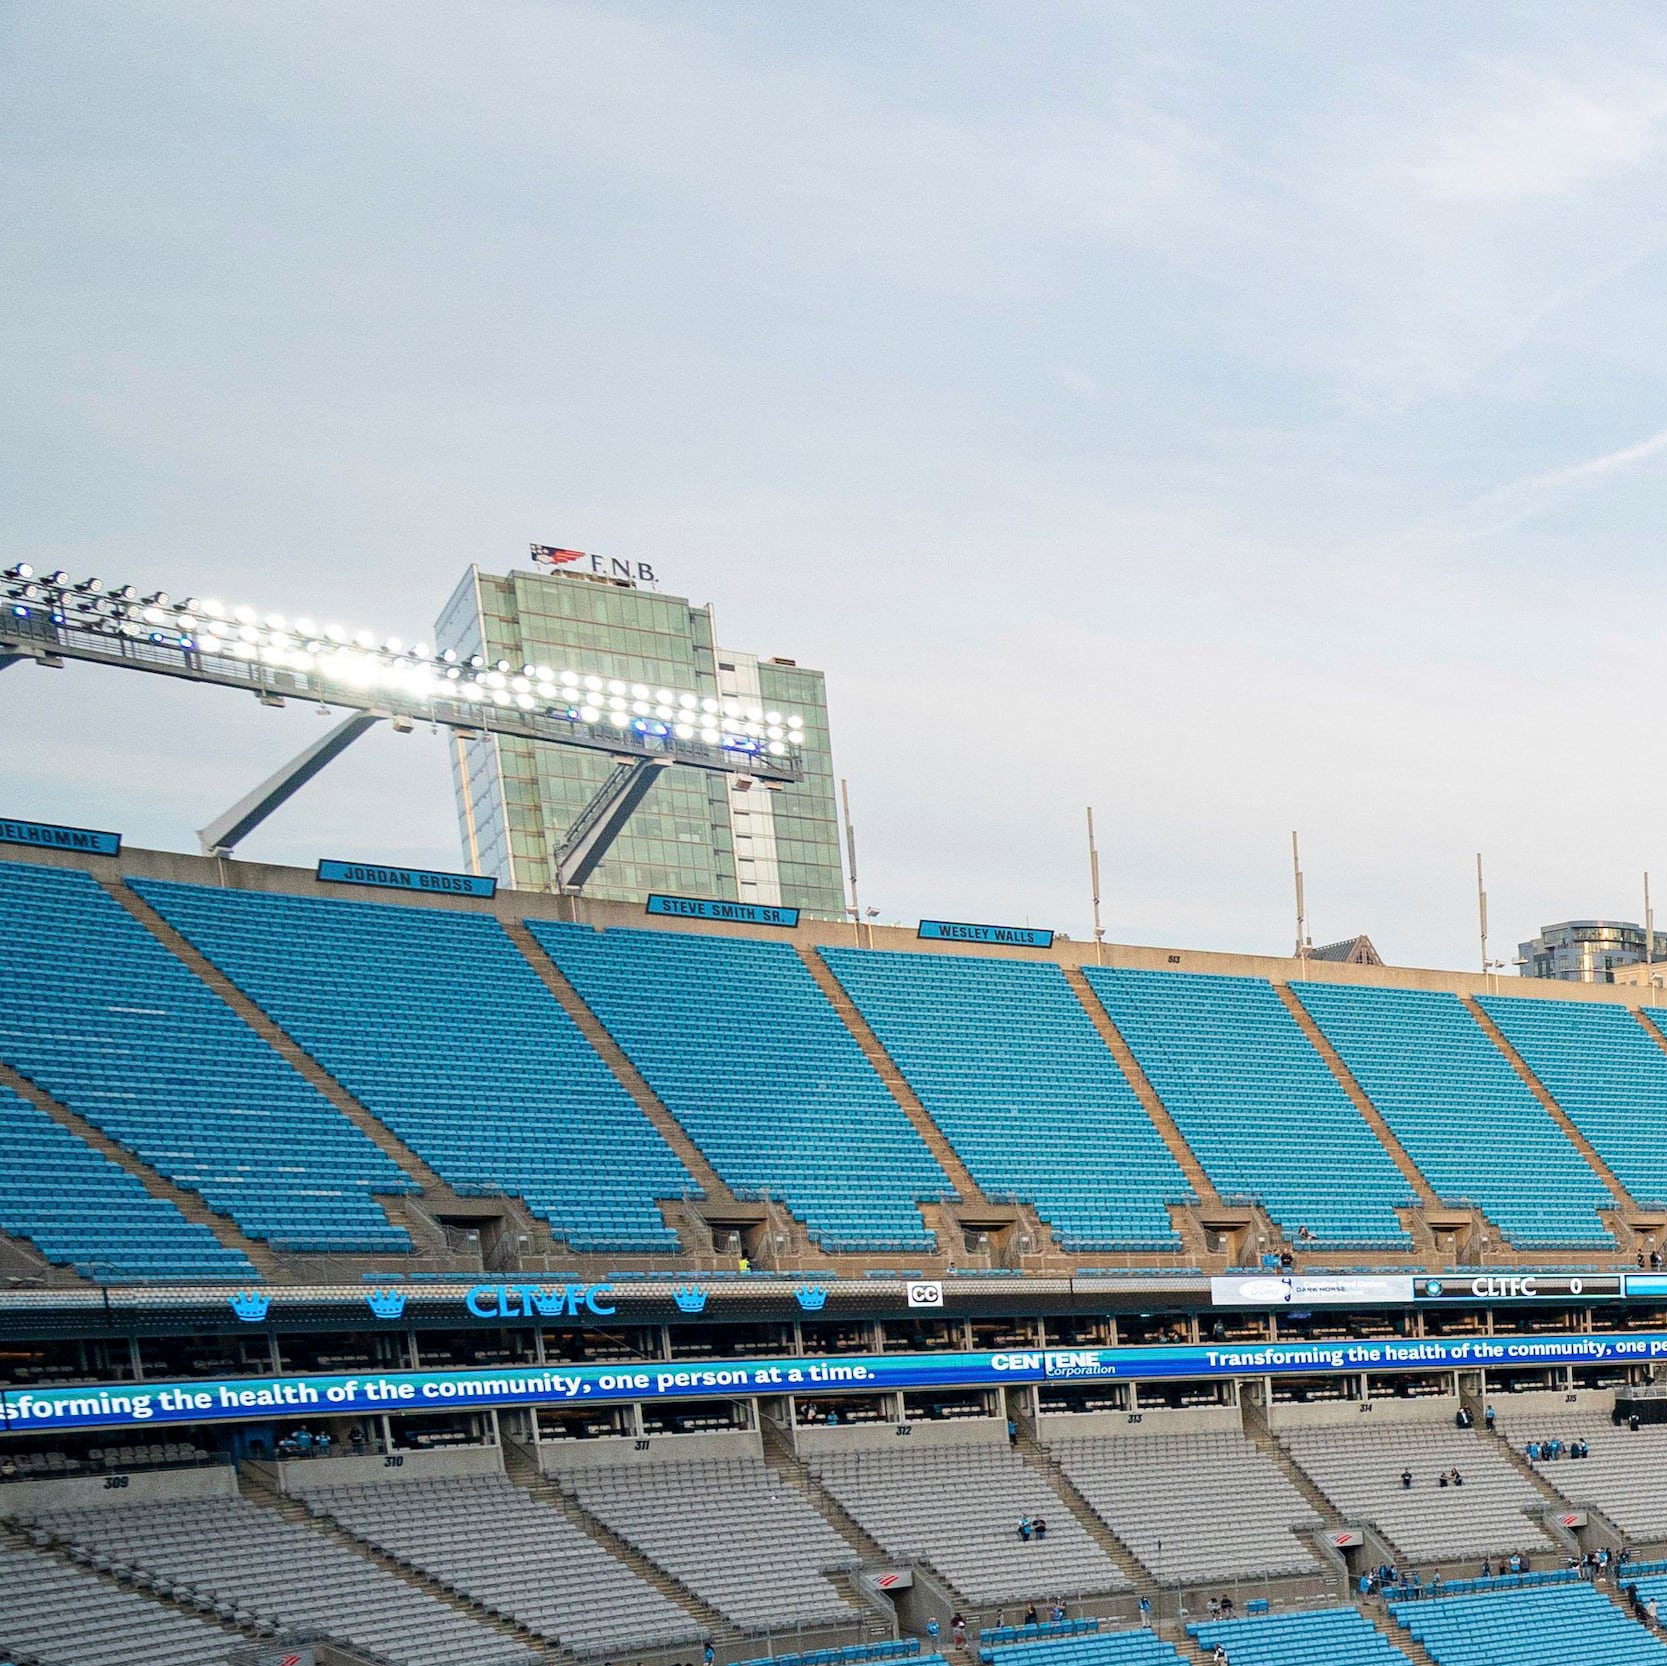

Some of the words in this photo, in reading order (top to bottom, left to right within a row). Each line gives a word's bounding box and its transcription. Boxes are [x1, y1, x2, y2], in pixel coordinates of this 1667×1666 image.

[590, 554, 660, 582] F.N.B.
[344, 866, 410, 885] JORDAN
[419, 873, 473, 892] GROSS
[662, 900, 706, 915] STEVE
[712, 905, 756, 920] SMITH
[763, 910, 785, 923] SR.
[938, 925, 989, 940] WESLEY
[993, 929, 1035, 943] WALLS
[911, 1286, 939, 1304] CC
[1472, 1277, 1537, 1297] CLTFC
[1570, 1278, 1582, 1295] 0
[992, 1351, 1100, 1370] CENTENE
[1207, 1349, 1345, 1368] Transforming
[1347, 1346, 1381, 1363] the
[1384, 1344, 1447, 1361] health
[1450, 1343, 1471, 1358] of
[1474, 1342, 1504, 1356] the
[1508, 1339, 1611, 1358] community,
[1615, 1340, 1647, 1353] one
[1046, 1364, 1116, 1377] Corporation
[160, 1387, 211, 1412] the
[219, 1383, 319, 1408] health
[327, 1380, 358, 1402] of
[364, 1381, 415, 1402] the
[422, 1372, 591, 1398] community,
[598, 1372, 650, 1390] one
[658, 1368, 748, 1393] person
[754, 1366, 781, 1384] at
[788, 1367, 804, 1383] a
[808, 1362, 876, 1382] time.
[1128, 1414, 1142, 1424] 313
[896, 1426, 912, 1436] 312
[634, 1440, 650, 1450] 311
[384, 1456, 403, 1467] 310
[104, 1476, 129, 1489] 309
